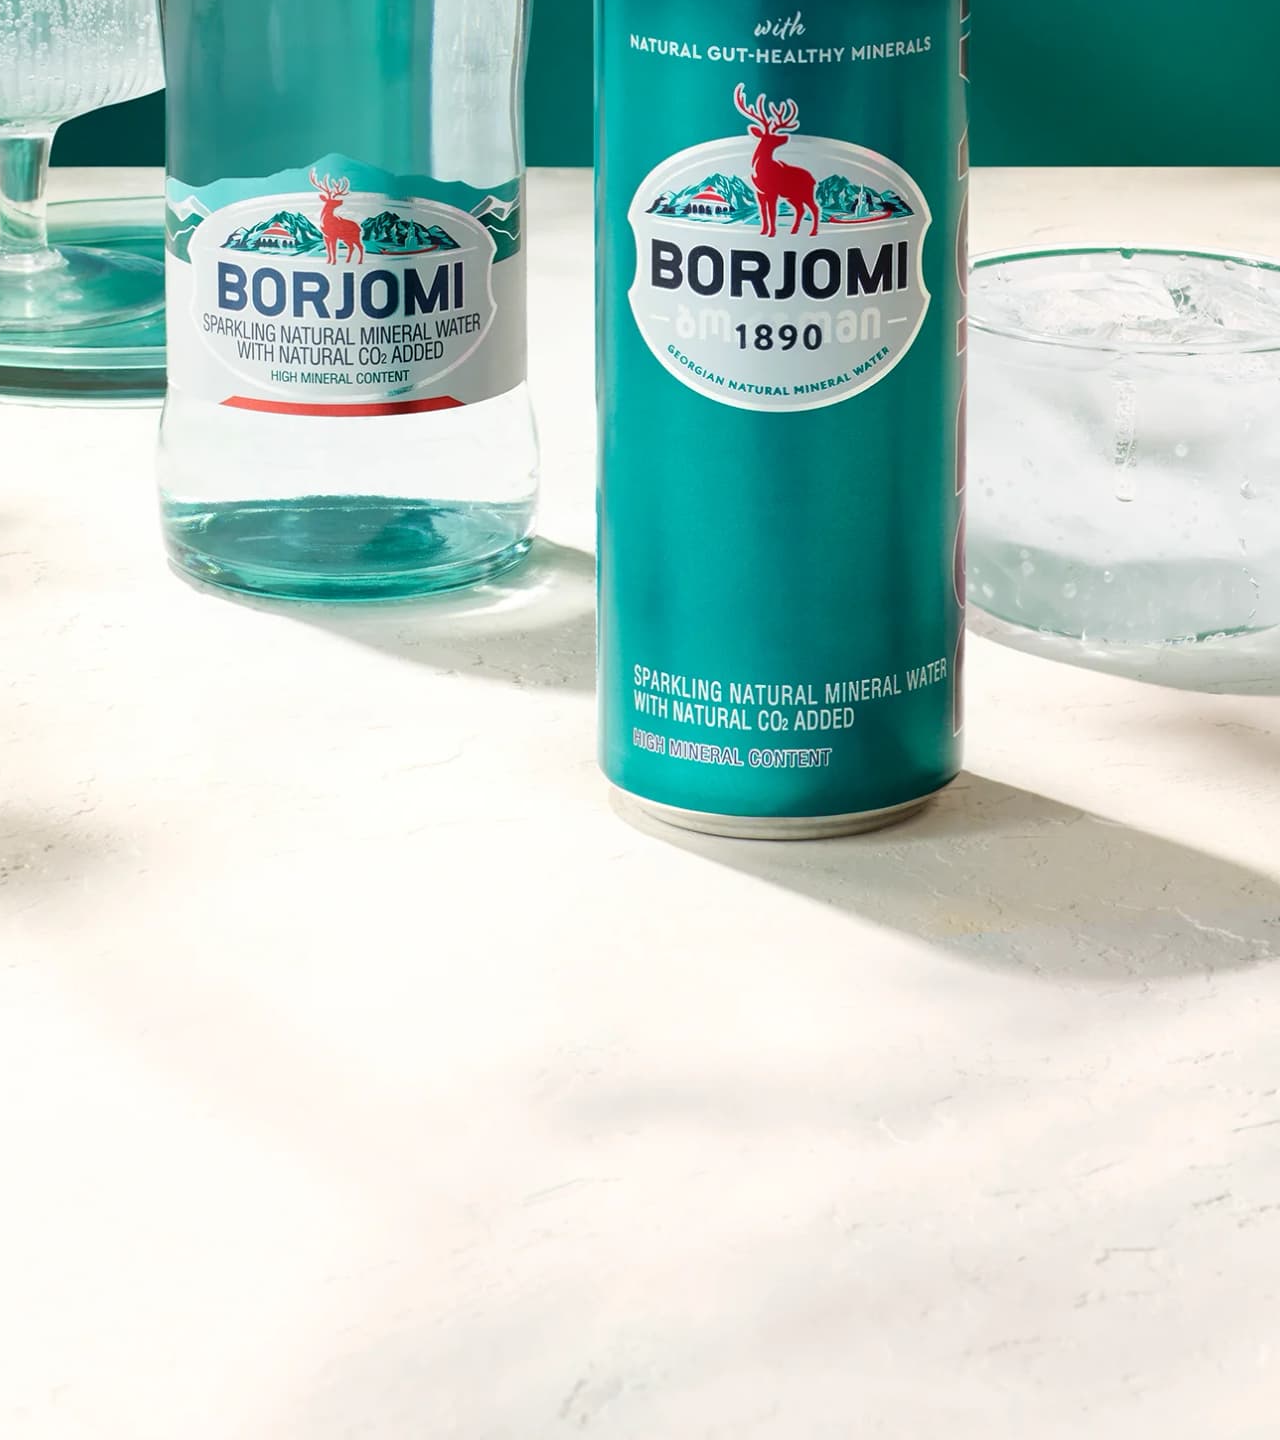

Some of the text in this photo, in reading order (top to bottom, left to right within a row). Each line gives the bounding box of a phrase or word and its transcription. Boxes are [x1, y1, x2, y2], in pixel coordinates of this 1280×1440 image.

[753, 10, 806, 40] with
[629, 33, 932, 64] NATURAL GUT-HEALTHY MINERALS
[651, 238, 908, 300] BORJOMI
[218, 261, 463, 320] BORJOMI
[203, 313, 481, 346] SPARKLING NATURAL MINERAL WATER
[735, 323, 823, 351] 1890
[237, 340, 274, 363] WITH
[279, 344, 354, 366] NATURAL
[391, 340, 445, 364] ADDED
[667, 344, 890, 396] GEORGIAN NATURAL MINERAL WATER
[271, 369, 410, 385] HIGH MINERAL CONTENT
[633, 657, 948, 706] SPARKLING NATURAL MINERAL WATER
[634, 688, 668, 720] WITH
[673, 696, 752, 731] NATURAL
[793, 706, 855, 731] ADDED
[632, 727, 833, 768] HIGH MINERAL CONTENT
